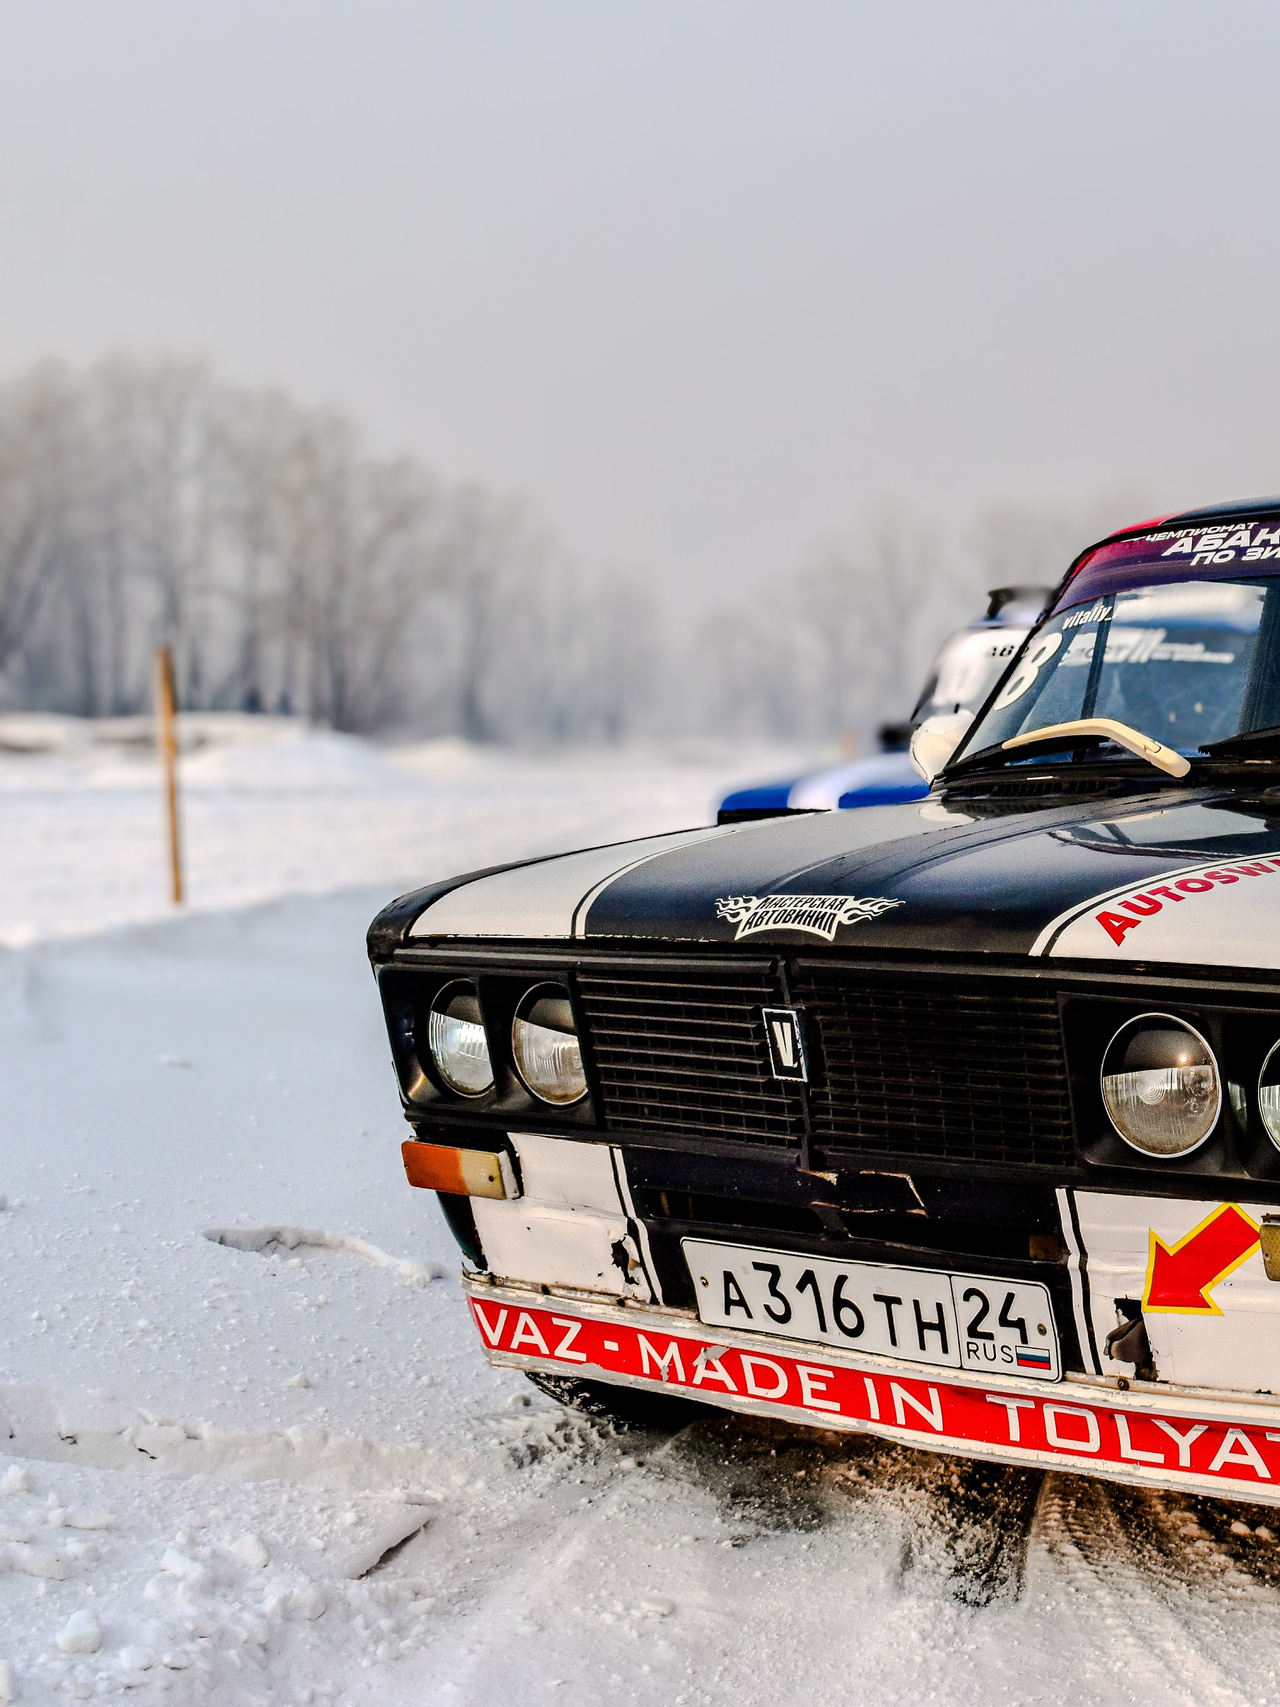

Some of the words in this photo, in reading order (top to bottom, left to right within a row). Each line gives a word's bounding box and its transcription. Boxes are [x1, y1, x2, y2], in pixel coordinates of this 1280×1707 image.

[1145, 522, 1259, 541] ЧЕМПИОНАТ
[1190, 549, 1236, 566] ПО
[755, 896, 848, 911] МАСТЕРСКАЯ
[962, 1287, 1028, 1345] 24
[966, 1341, 1014, 1364] RUS
[474, 1303, 587, 1361] VAZ
[637, 1333, 841, 1411] MADE
[863, 1377, 944, 1431] IN
